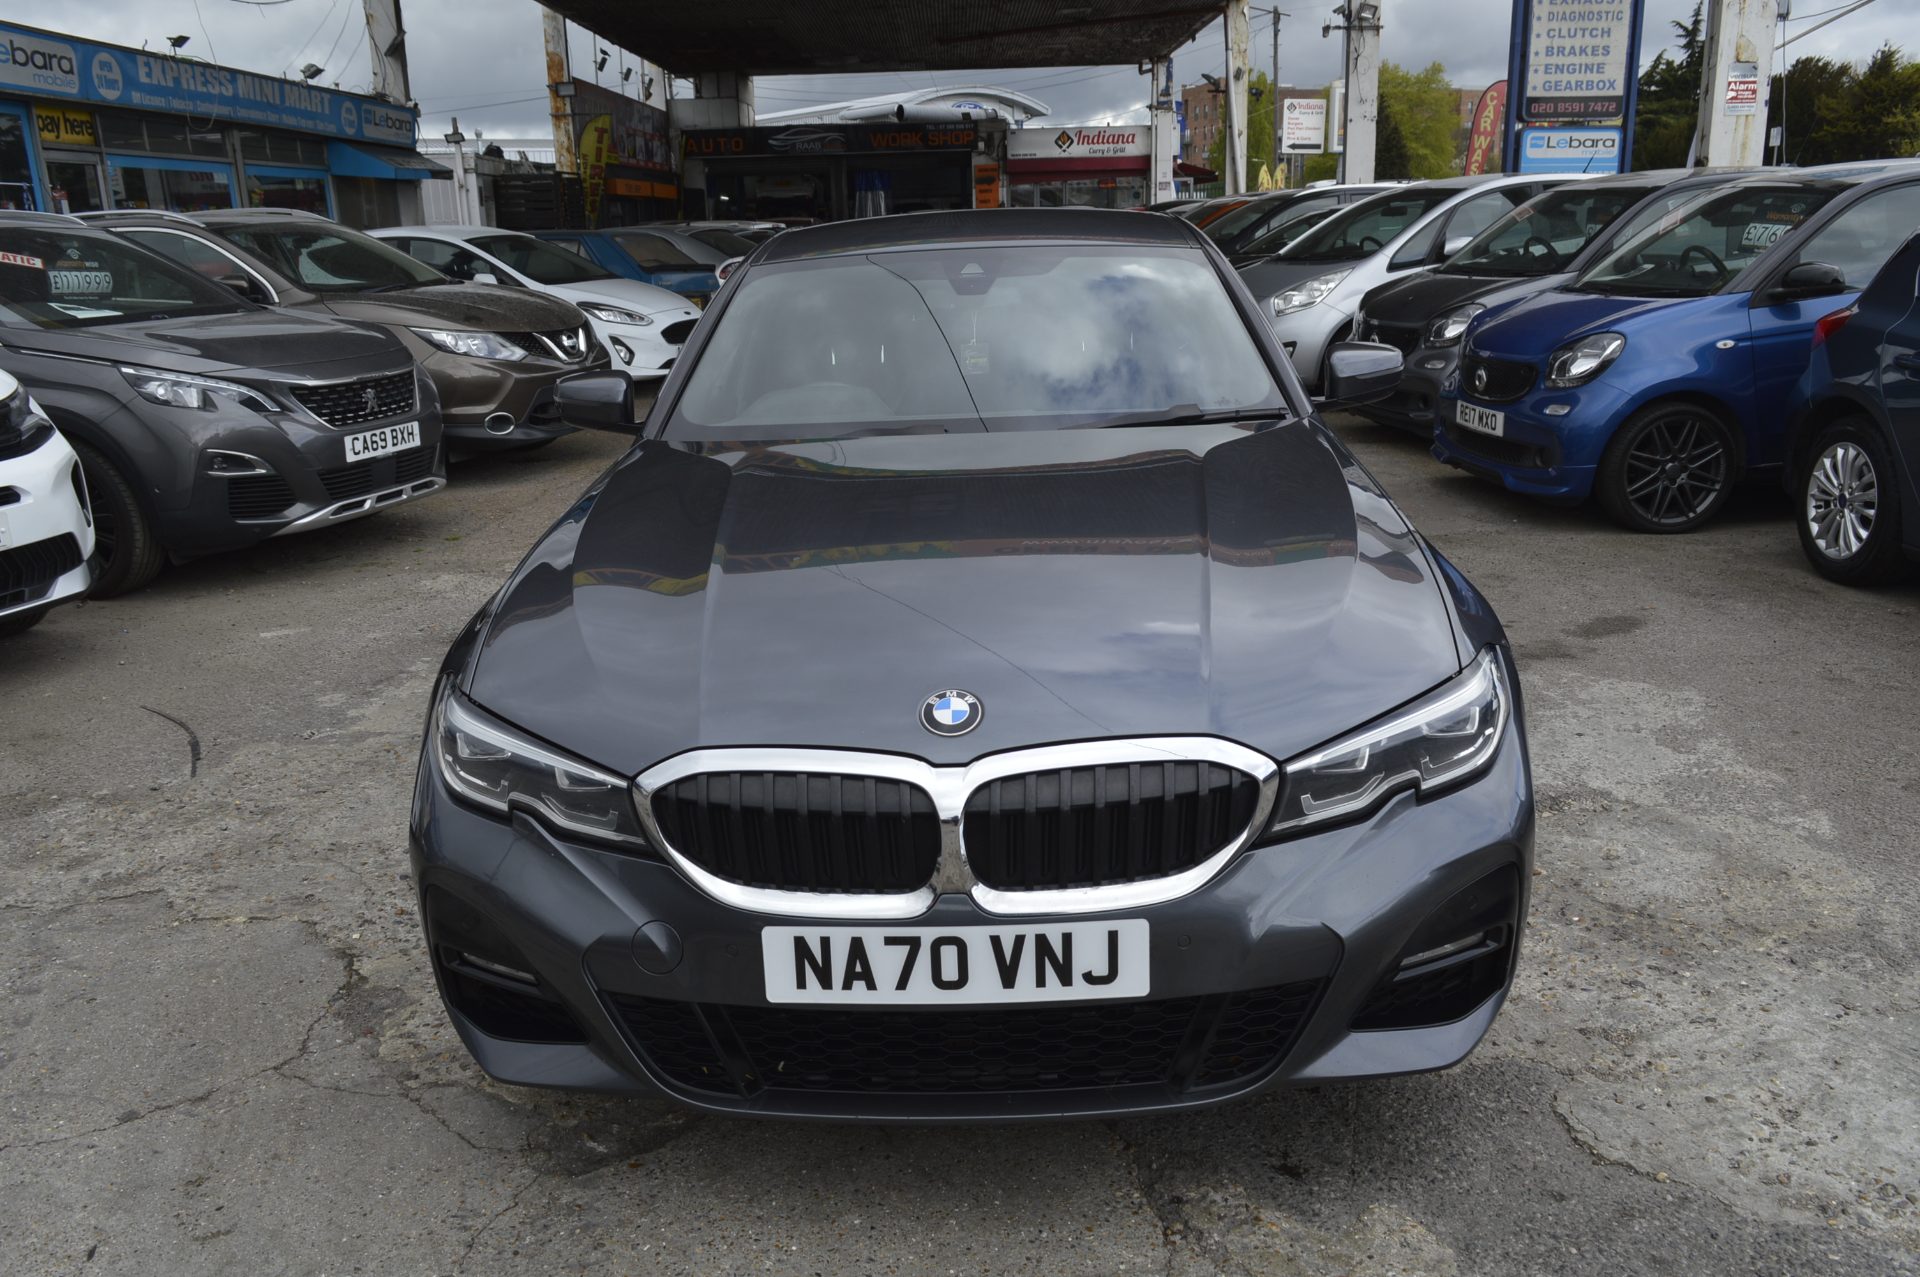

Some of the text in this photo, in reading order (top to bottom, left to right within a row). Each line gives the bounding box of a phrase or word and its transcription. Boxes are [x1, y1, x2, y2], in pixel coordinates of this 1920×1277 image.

[1547, 10, 1624, 22] DIAGNOSTIC
[1546, 27, 1612, 39] CLUTCH
[1544, 45, 1611, 57] BRAKES
[1543, 62, 1607, 75] ENGINE
[32, 72, 77, 89] mobile
[136, 54, 331, 114] EXPRESS MINI MART
[1542, 80, 1617, 92] GEARBOX
[1728, 81, 1757, 90] Alarm
[1297, 102, 1324, 110] Indiana
[1480, 91, 1498, 132] CAR
[1530, 102, 1617, 113] 020 8591 7472
[36, 110, 93, 139] pay here
[374, 110, 412, 132] Lebara
[686, 137, 744, 154] AUTO
[870, 130, 976, 148] WORK SHOP
[1074, 129, 1137, 146] Indiana
[1546, 135, 1616, 149] Lebara
[1088, 147, 1106, 156] Curry
[1112, 146, 1126, 156] Grill
[52, 273, 112, 291] £11999
[351, 424, 415, 456] CA69 BXH
[793, 929, 1119, 991] NA70 VNJ
